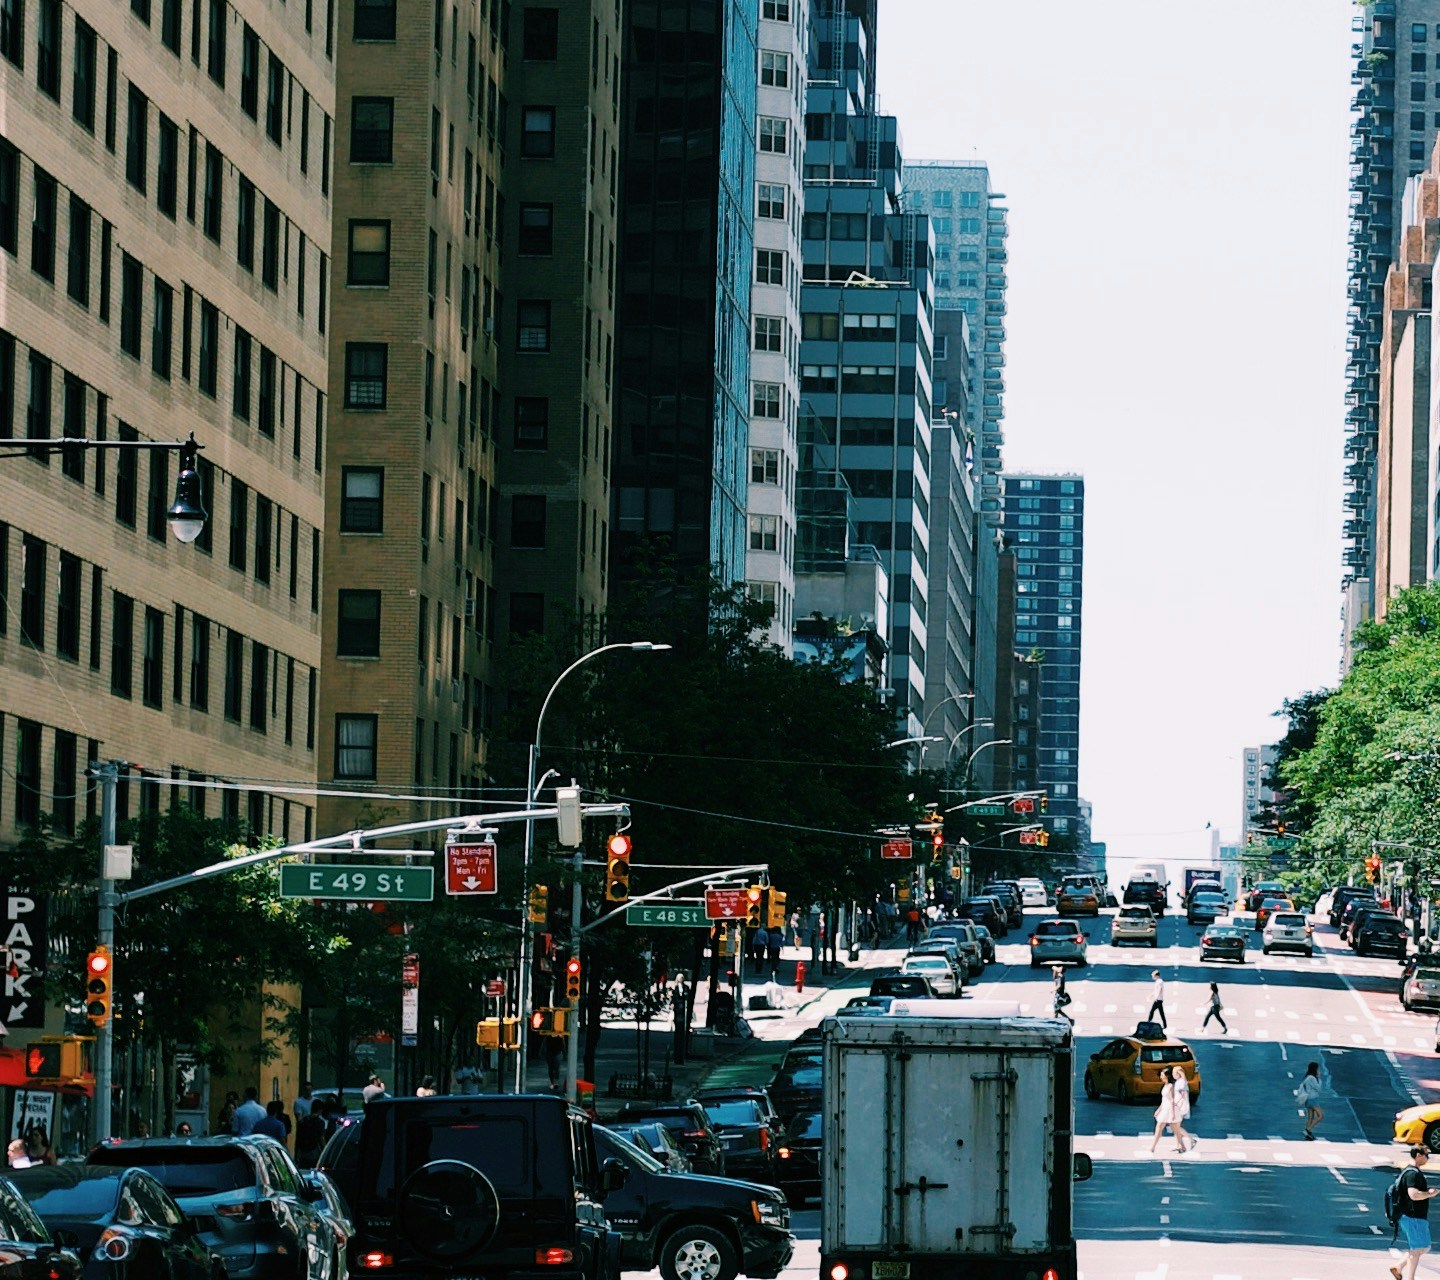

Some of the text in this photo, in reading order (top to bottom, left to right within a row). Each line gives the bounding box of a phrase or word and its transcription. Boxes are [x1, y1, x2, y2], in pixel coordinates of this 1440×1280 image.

[309, 871, 405, 894] E 49 St
[643, 910, 699, 923] E 48 St
